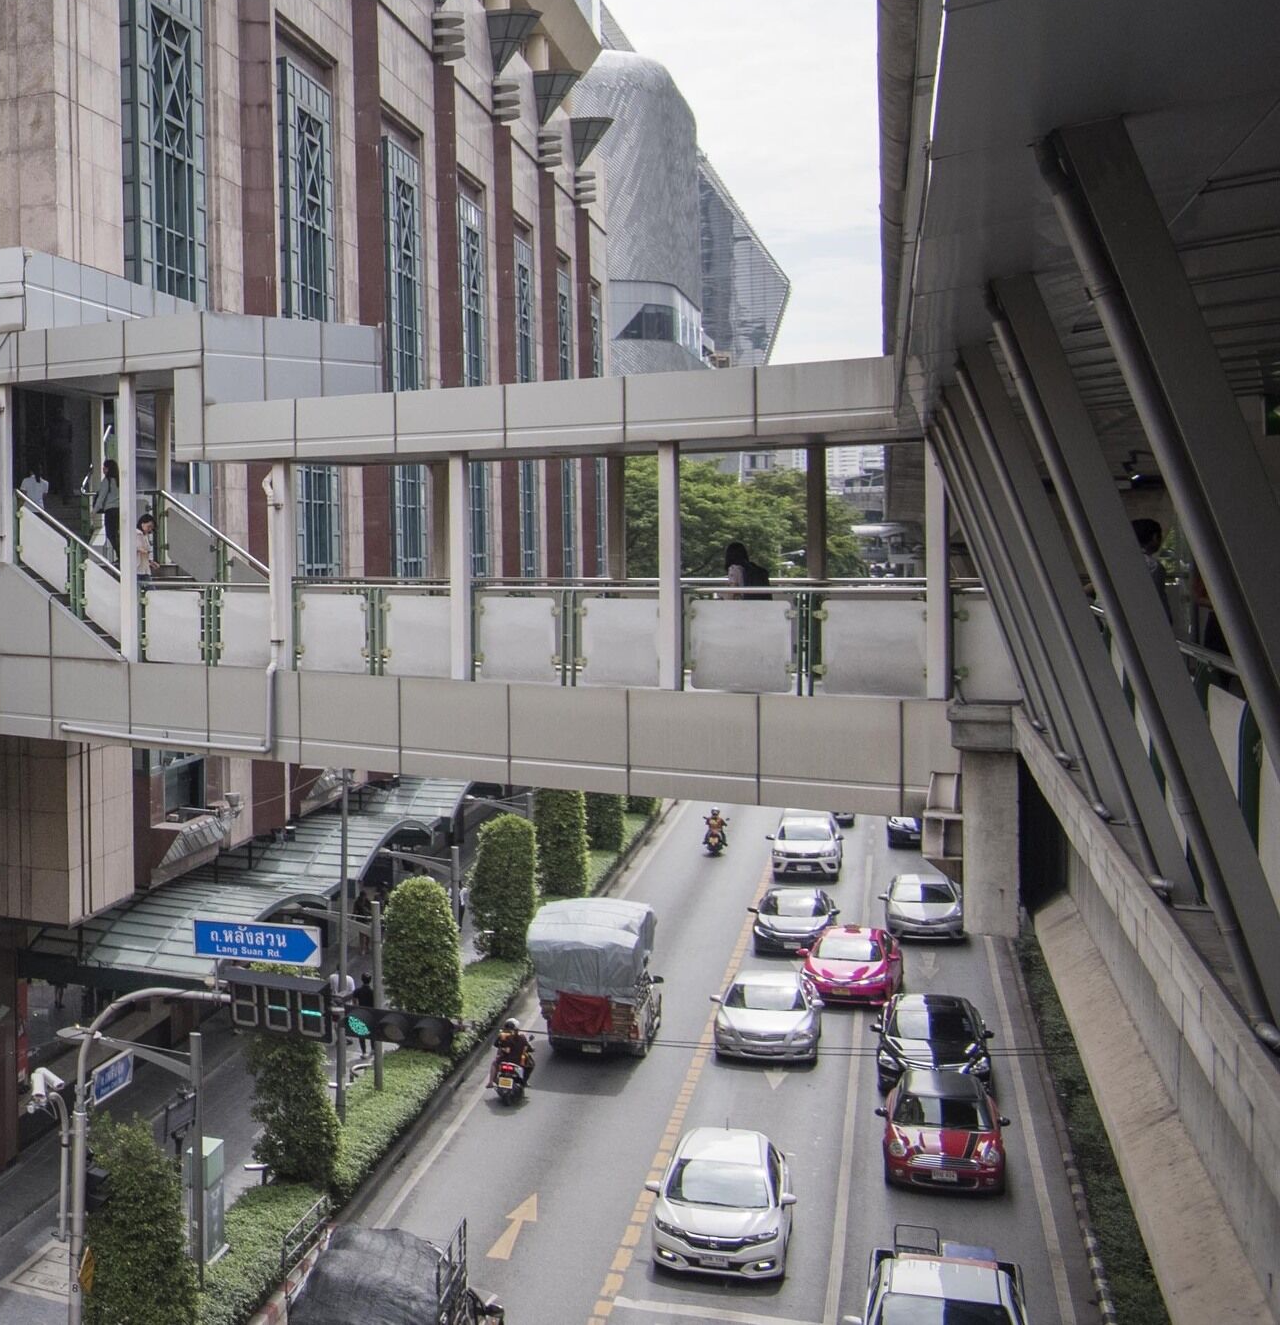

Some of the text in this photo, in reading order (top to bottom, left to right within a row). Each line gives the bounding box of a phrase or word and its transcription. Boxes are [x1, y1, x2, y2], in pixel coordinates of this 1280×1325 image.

[210, 926, 287, 948] ถ.หลังสวน
[216, 944, 282, 958] Lang Suan Rd.
[71, 1283, 79, 1293] 8
